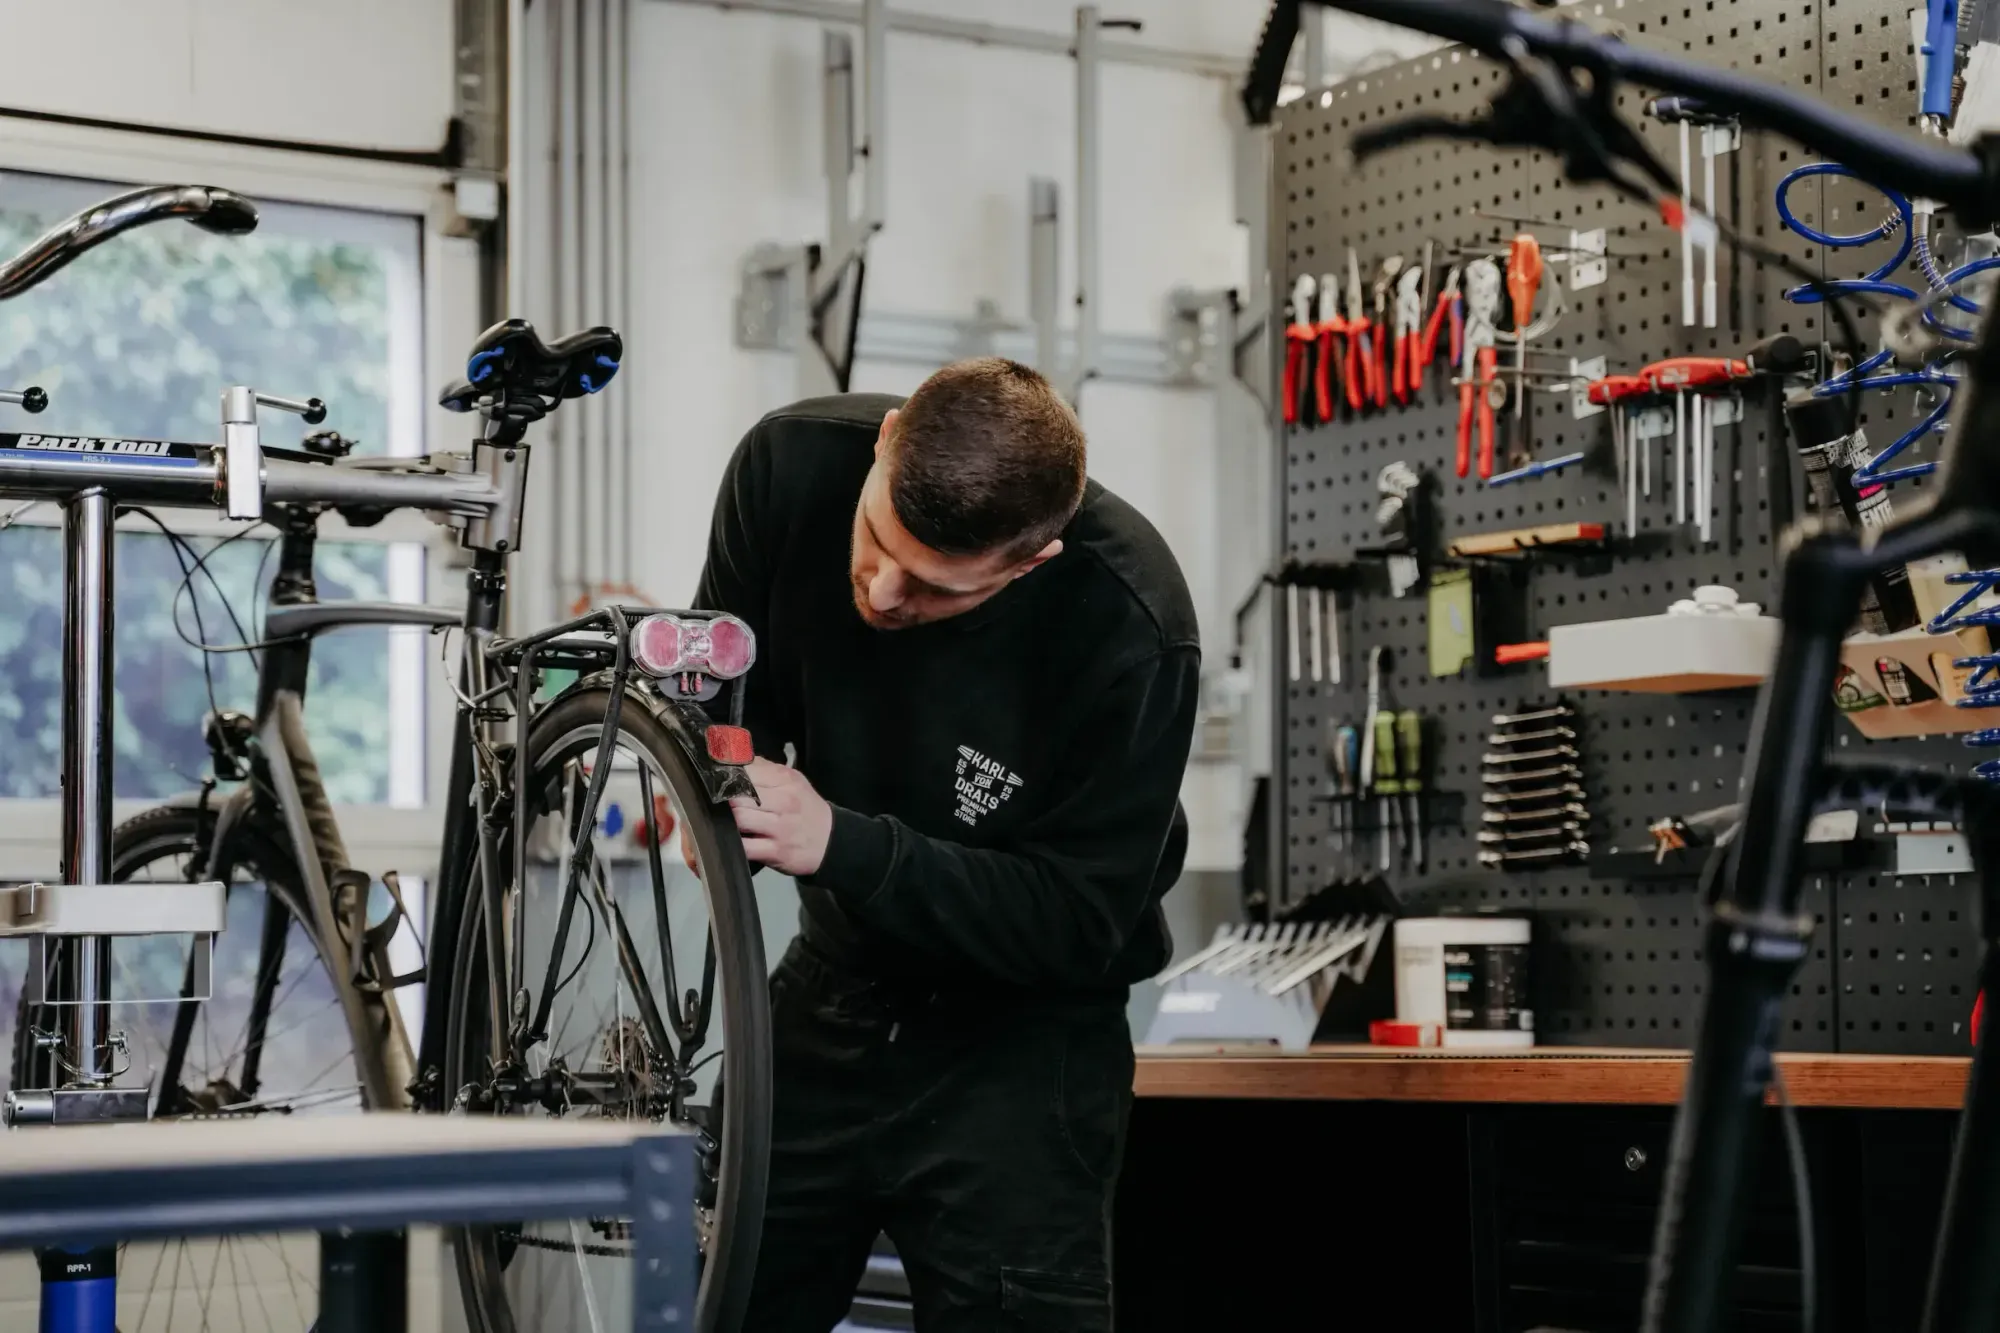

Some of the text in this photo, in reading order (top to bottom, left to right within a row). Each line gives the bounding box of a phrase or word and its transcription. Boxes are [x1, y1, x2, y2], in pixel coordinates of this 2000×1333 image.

[16, 433, 97, 453] Park
[971, 751, 1006, 781] KARL
[974, 774, 993, 787] VON
[954, 776, 1000, 809] DRAIS
[954, 808, 977, 827] STORE
[960, 803, 977, 818] BIKE
[67, 1263, 91, 1273] RPP-1
